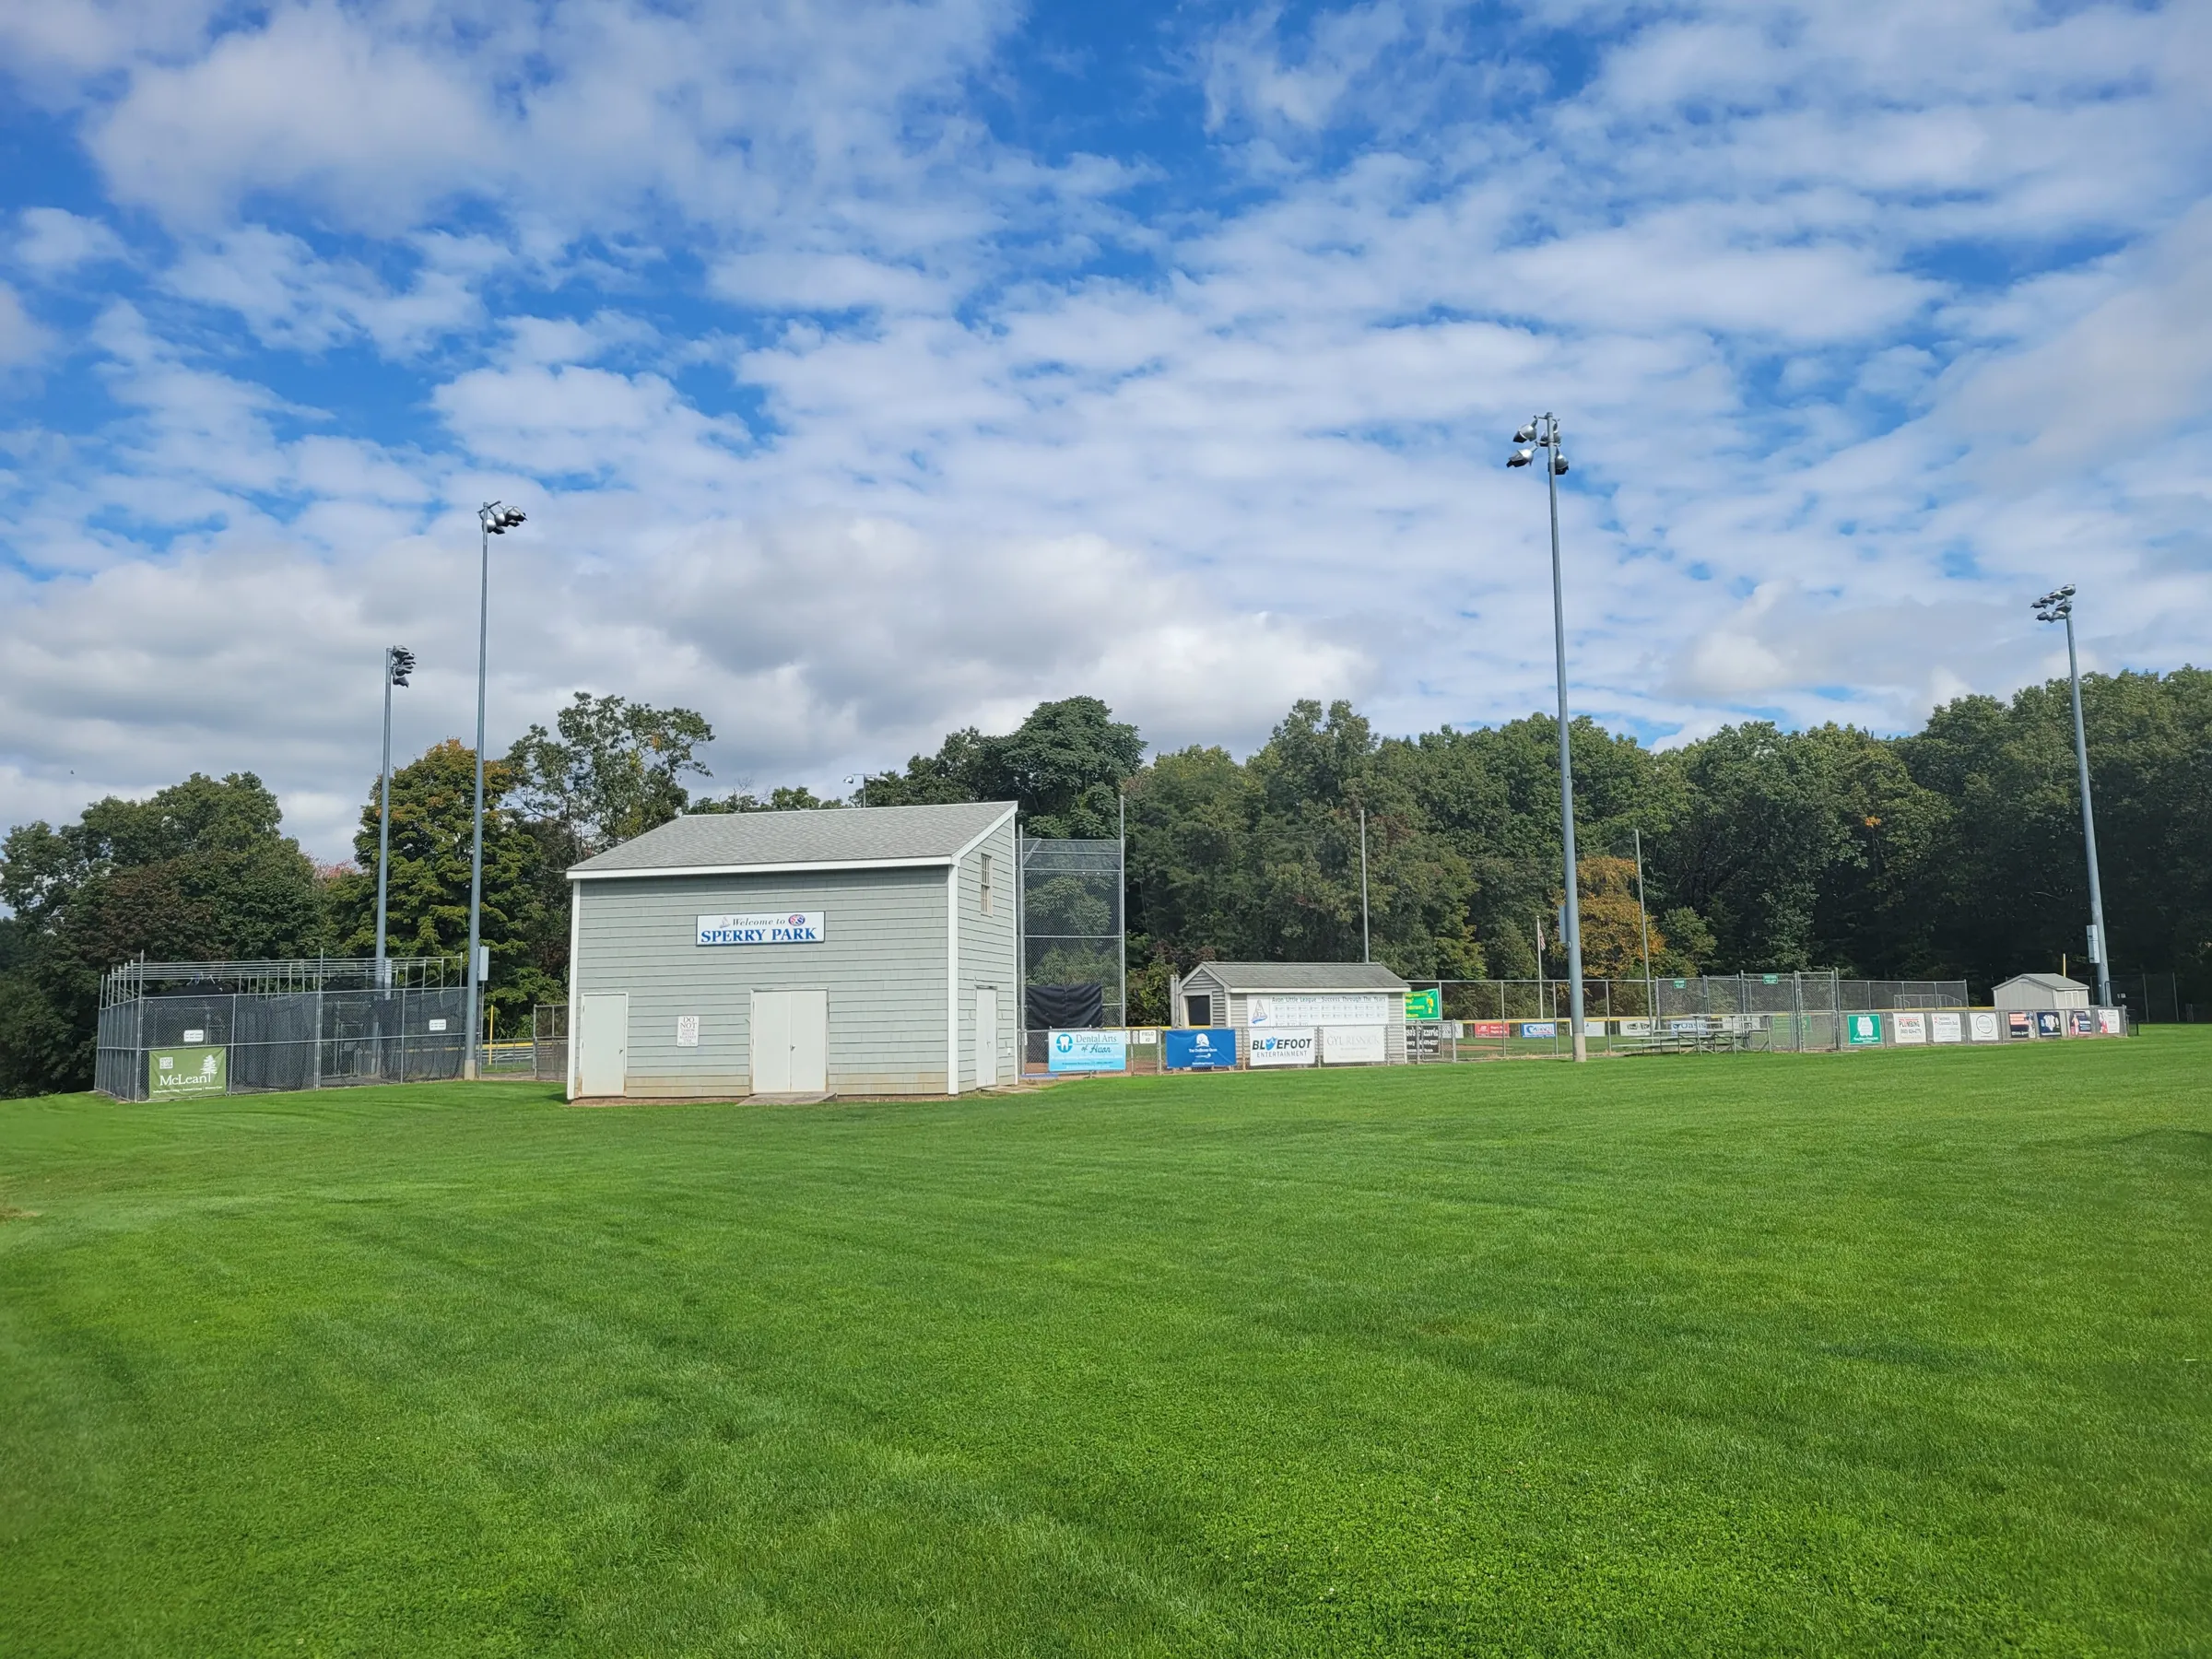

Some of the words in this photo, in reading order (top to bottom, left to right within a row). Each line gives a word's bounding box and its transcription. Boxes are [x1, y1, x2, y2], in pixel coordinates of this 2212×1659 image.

[733, 918, 773, 926] Welcome
[701, 929, 767, 943] SPERRY
[771, 927, 817, 941] PARK
[1077, 1034, 1100, 1043] Dental
[1101, 1034, 1117, 1042] Arts
[1327, 1036, 1343, 1046] GYL
[1081, 1045, 1088, 1053] of
[159, 1074, 207, 1086] McLean
